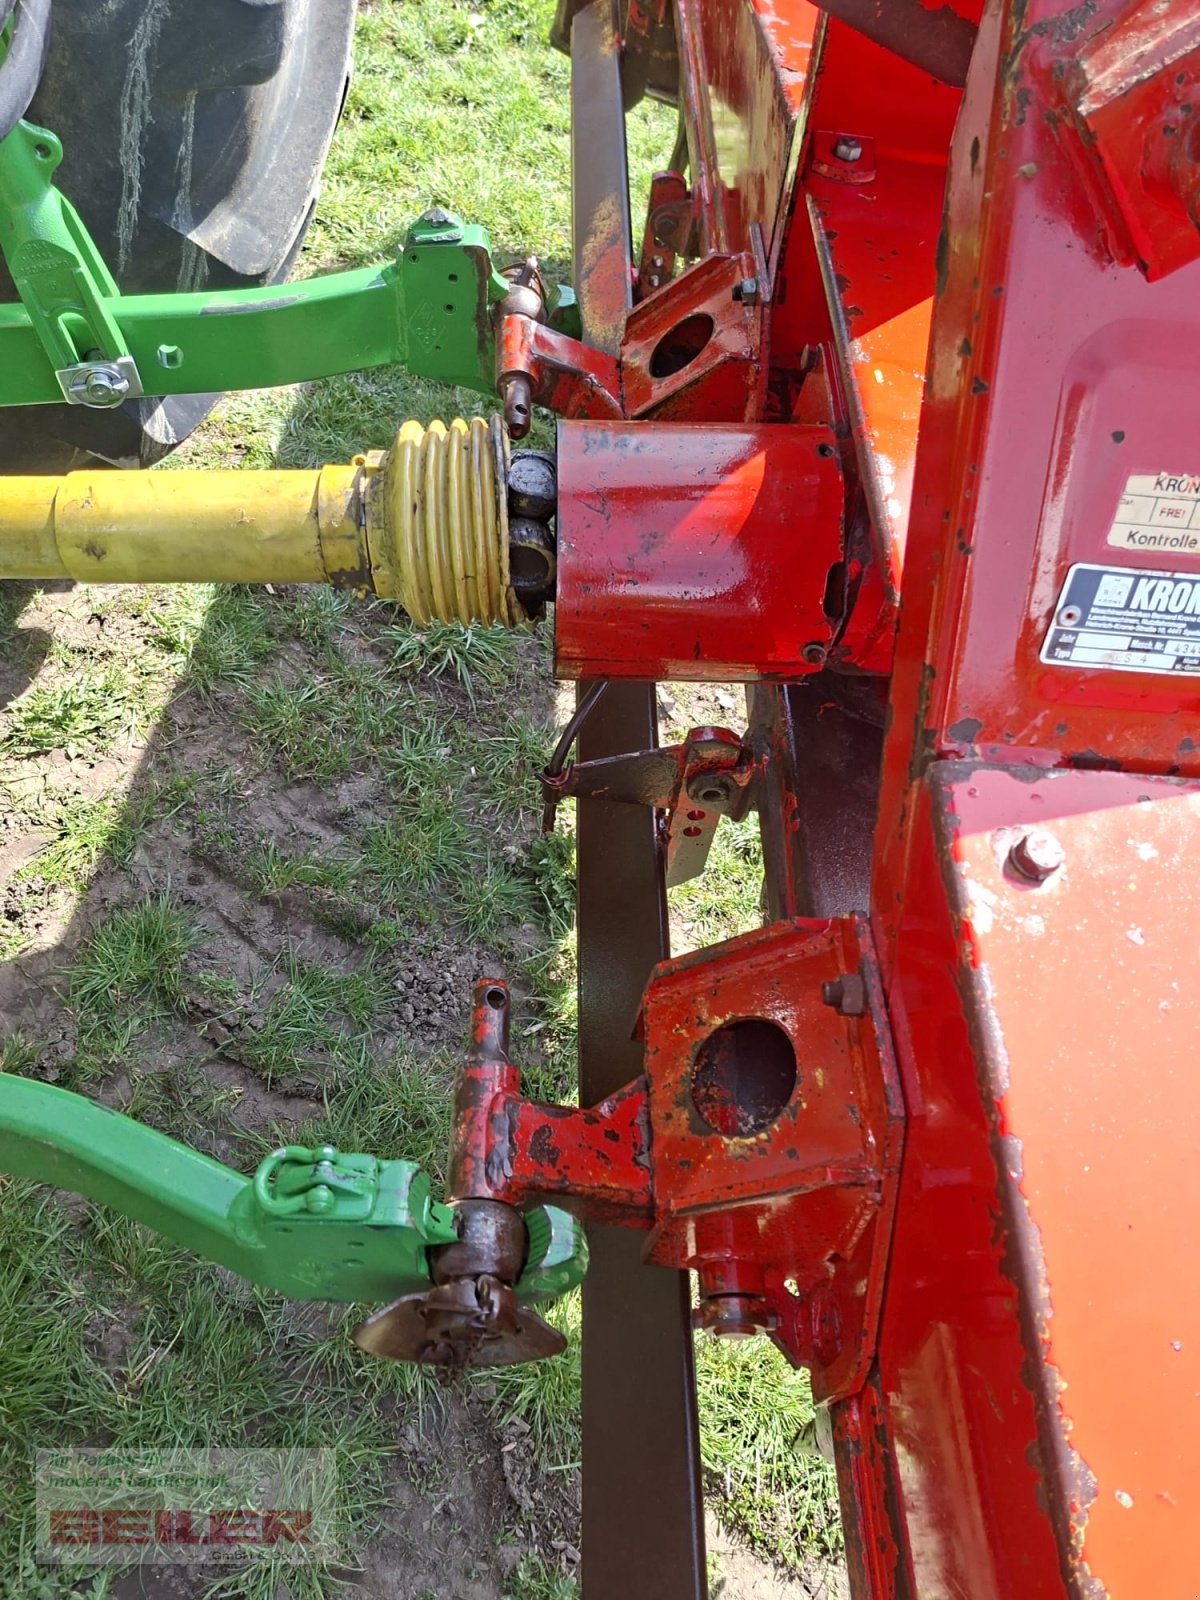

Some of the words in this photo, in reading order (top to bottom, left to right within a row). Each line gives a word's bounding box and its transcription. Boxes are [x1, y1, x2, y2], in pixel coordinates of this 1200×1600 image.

[1153, 475, 1200, 495] KRON
[1126, 530, 1198, 548] Kontrolle
[1058, 633, 1076, 643] Jahr
[1054, 647, 1071, 658] Type
